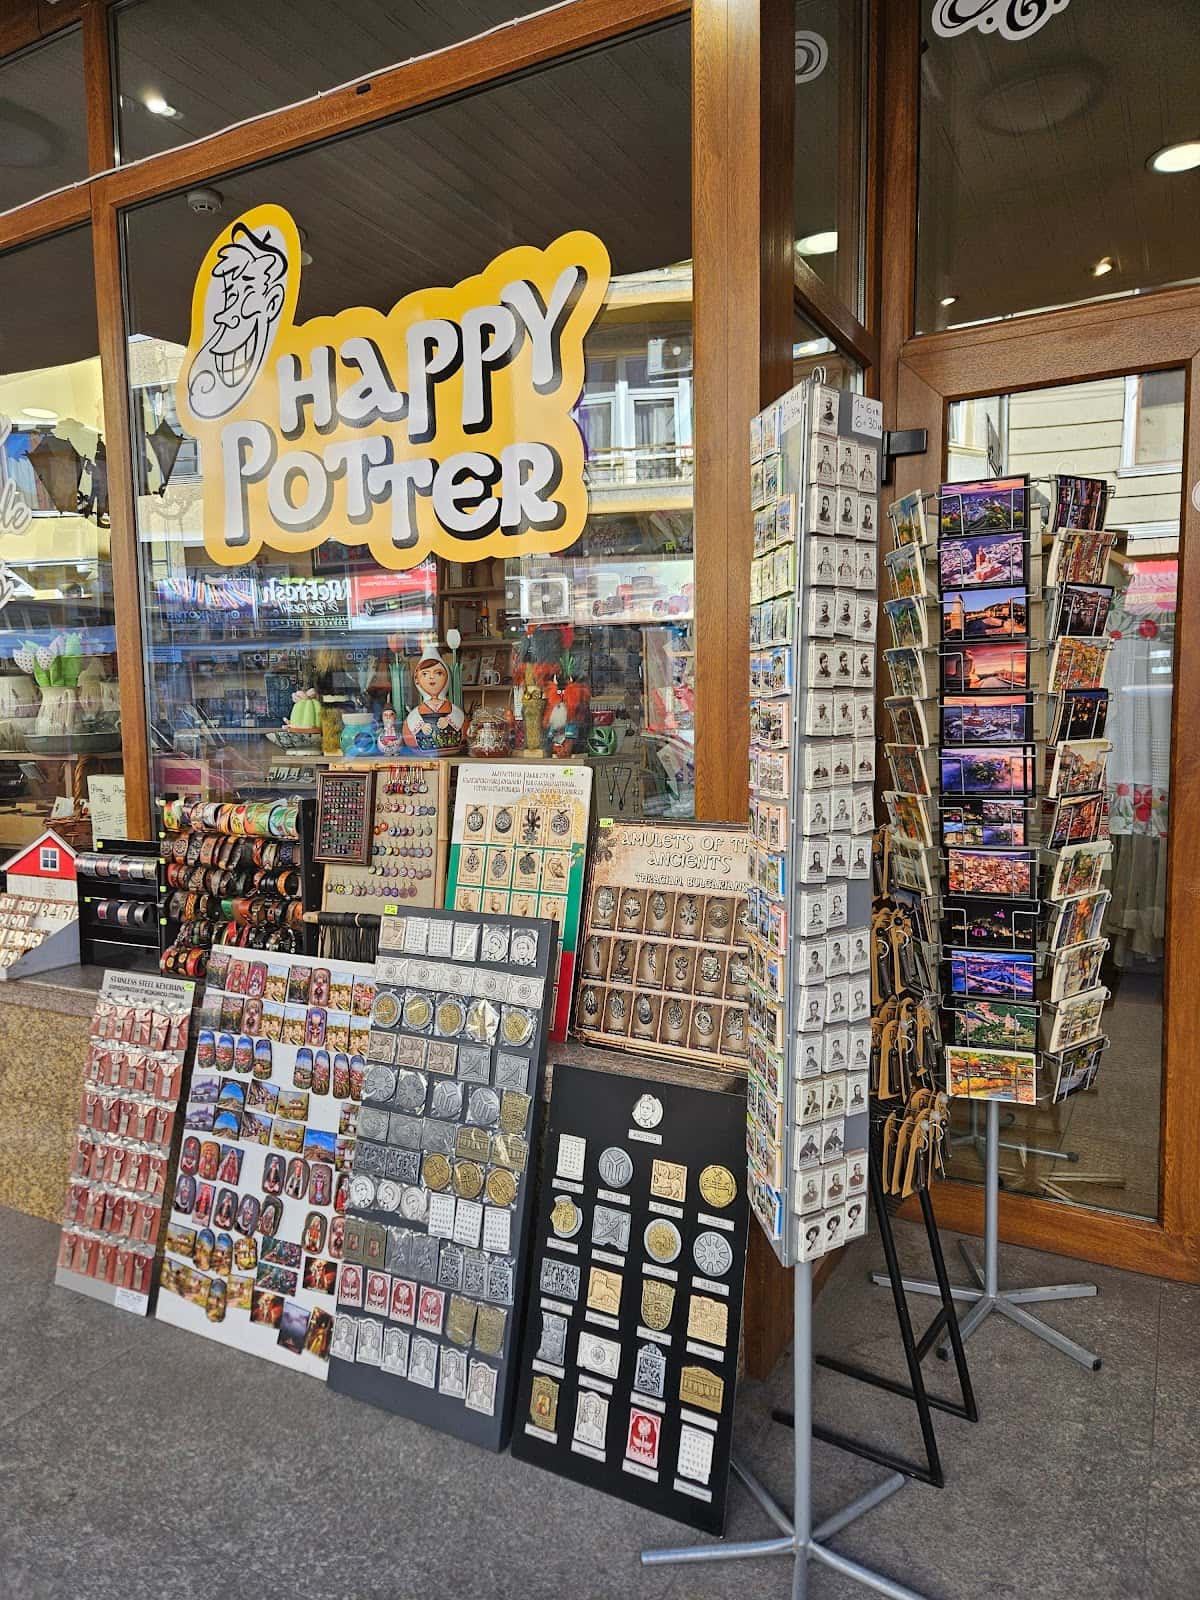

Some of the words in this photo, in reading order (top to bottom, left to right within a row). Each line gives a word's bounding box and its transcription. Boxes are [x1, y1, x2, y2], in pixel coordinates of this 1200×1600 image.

[621, 830, 696, 853] AMULETS
[702, 835, 725, 853] OF
[647, 850, 734, 874] ANCIENTS
